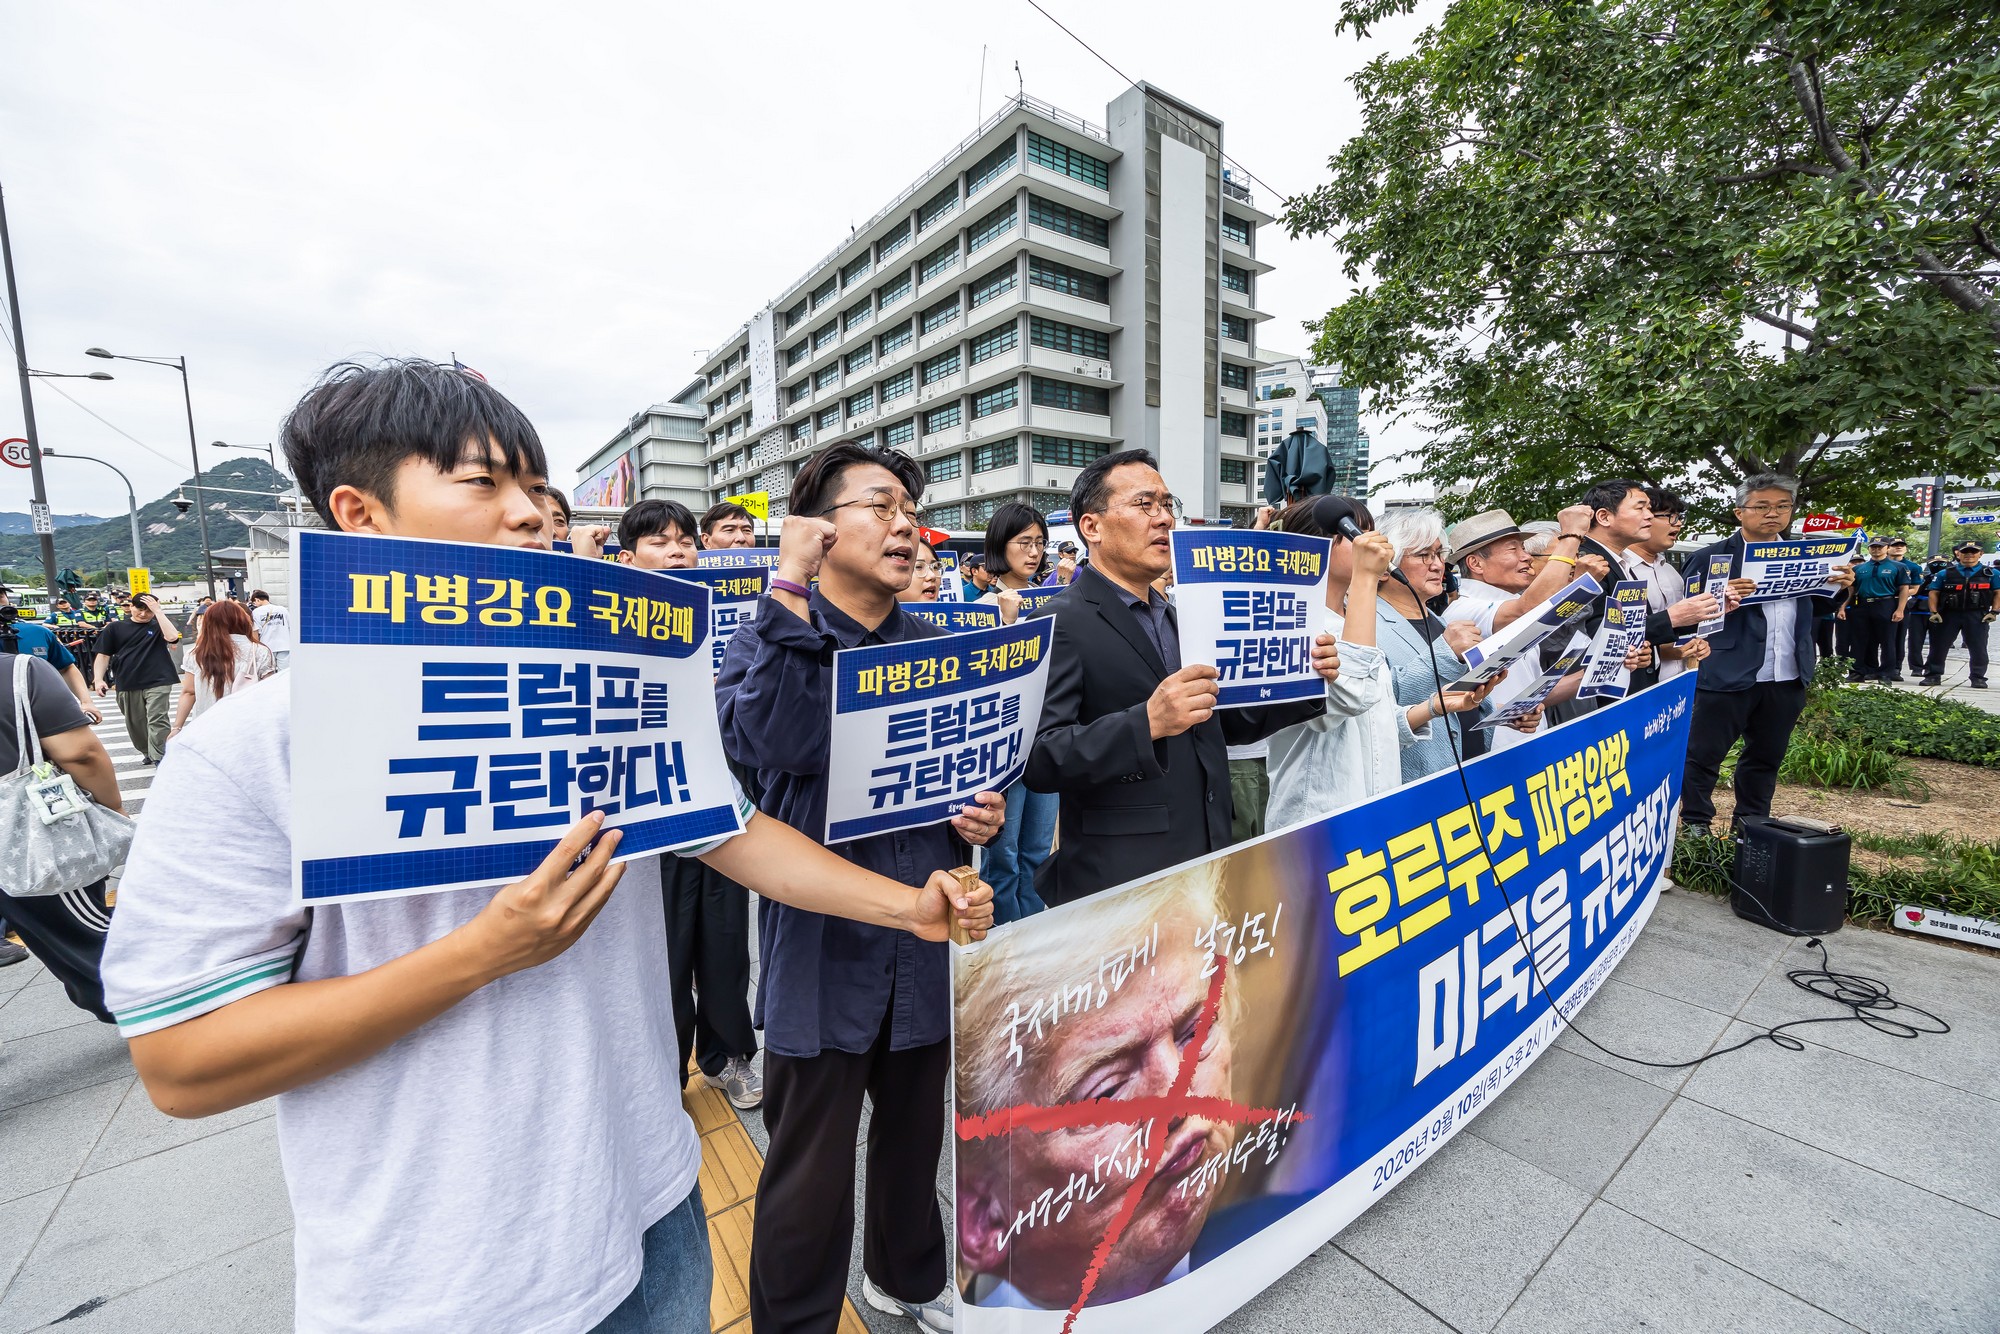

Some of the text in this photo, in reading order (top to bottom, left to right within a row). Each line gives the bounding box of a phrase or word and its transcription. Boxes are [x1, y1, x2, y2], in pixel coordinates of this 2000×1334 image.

[8, 447, 30, 460] 50
[1806, 518, 1840, 528] 43기-1
[698, 555, 746, 568] 파병강요
[1191, 546, 1321, 577] 파병강요 국제깡패
[1753, 543, 1847, 558] 파병강요 국제깡패
[1764, 562, 1829, 579] 트럼프를
[347, 570, 694, 645] 파병강요 국제깡패
[713, 577, 762, 597] 국제깡패
[1222, 590, 1307, 632] 트럼프를
[1754, 577, 1829, 595] 규탄한다!
[952, 611, 996, 628] 국제깡패
[857, 635, 1041, 696] 파병강요 국제깡패
[1215, 636, 1310, 682] 규탄한다!
[418, 662, 668, 741] 트럼프를
[885, 691, 1020, 759] 트럼프를
[386, 740, 692, 840] 규탄한다!
[868, 727, 1023, 810] 규탄한다!
[1326, 729, 1632, 979] 호르무즈 파병압박
[1413, 773, 1671, 1088] 미국을 규탄한다!
[1000, 902, 1283, 1068] 국제깡패! 날강도!
[1372, 1126, 1429, 1192] 2026년
[1431, 1105, 1454, 1142] 9월
[1457, 1065, 1501, 1120] 10일(목)
[1503, 1045, 1524, 1079] 오후
[1525, 1026, 1542, 1059] 2시
[997, 1102, 1297, 1252] 내정간섭! 경제수탈!
